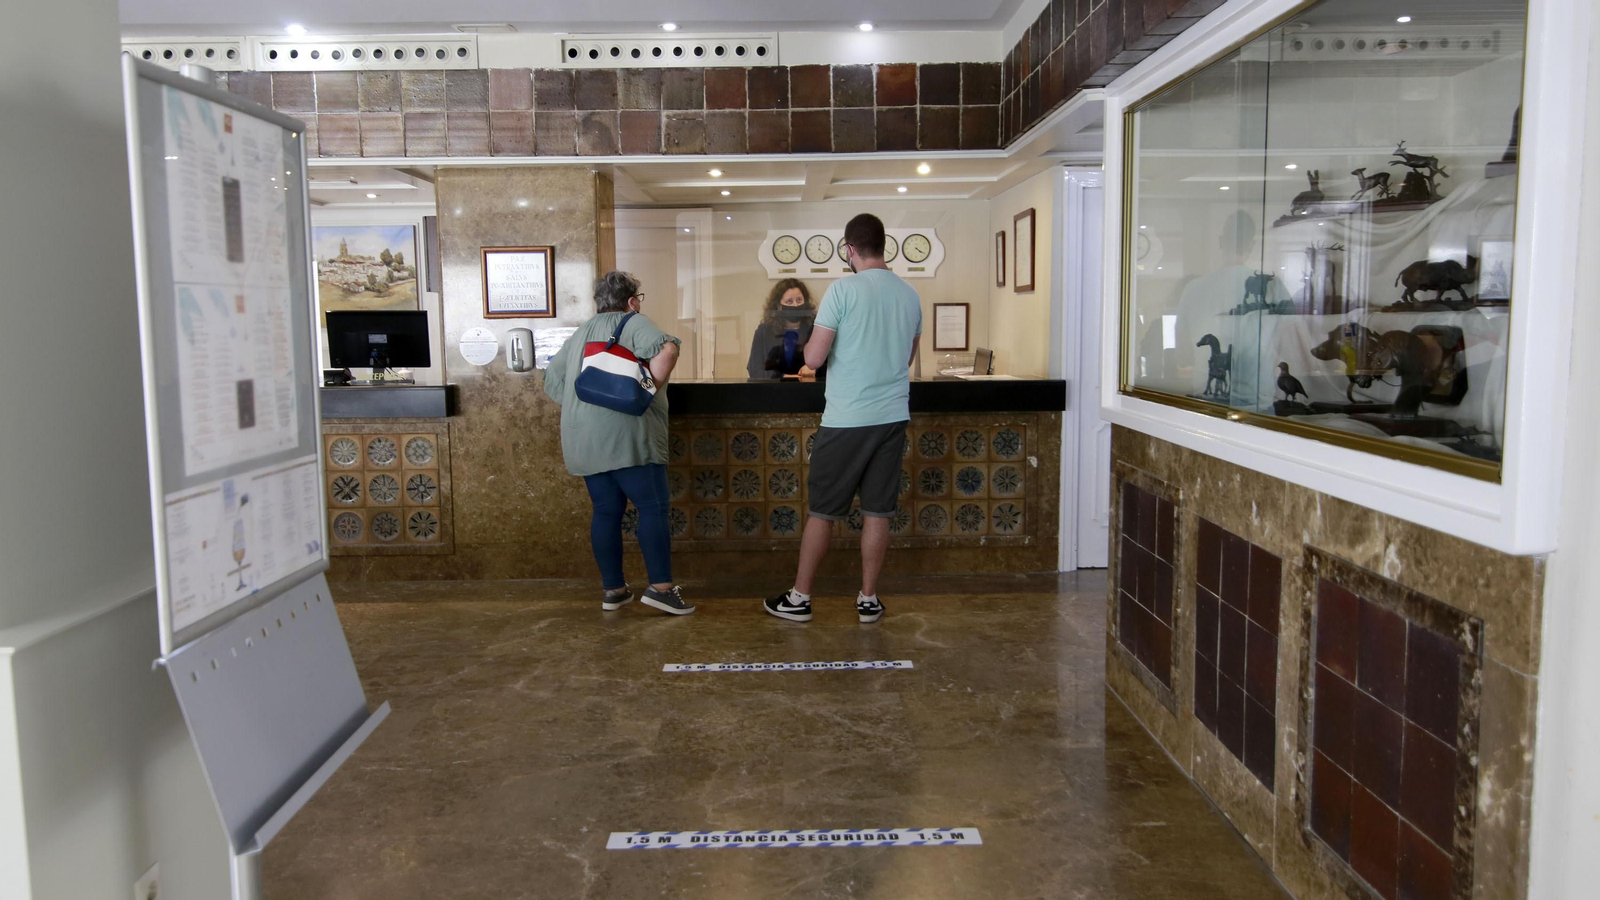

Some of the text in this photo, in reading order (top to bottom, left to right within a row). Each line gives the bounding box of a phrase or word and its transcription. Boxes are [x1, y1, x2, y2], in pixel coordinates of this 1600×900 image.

[657, 836, 672, 844] M
[690, 835, 789, 843] DISTANCIA
[795, 833, 900, 842] SEGURIDAD
[950, 832, 965, 840] M
